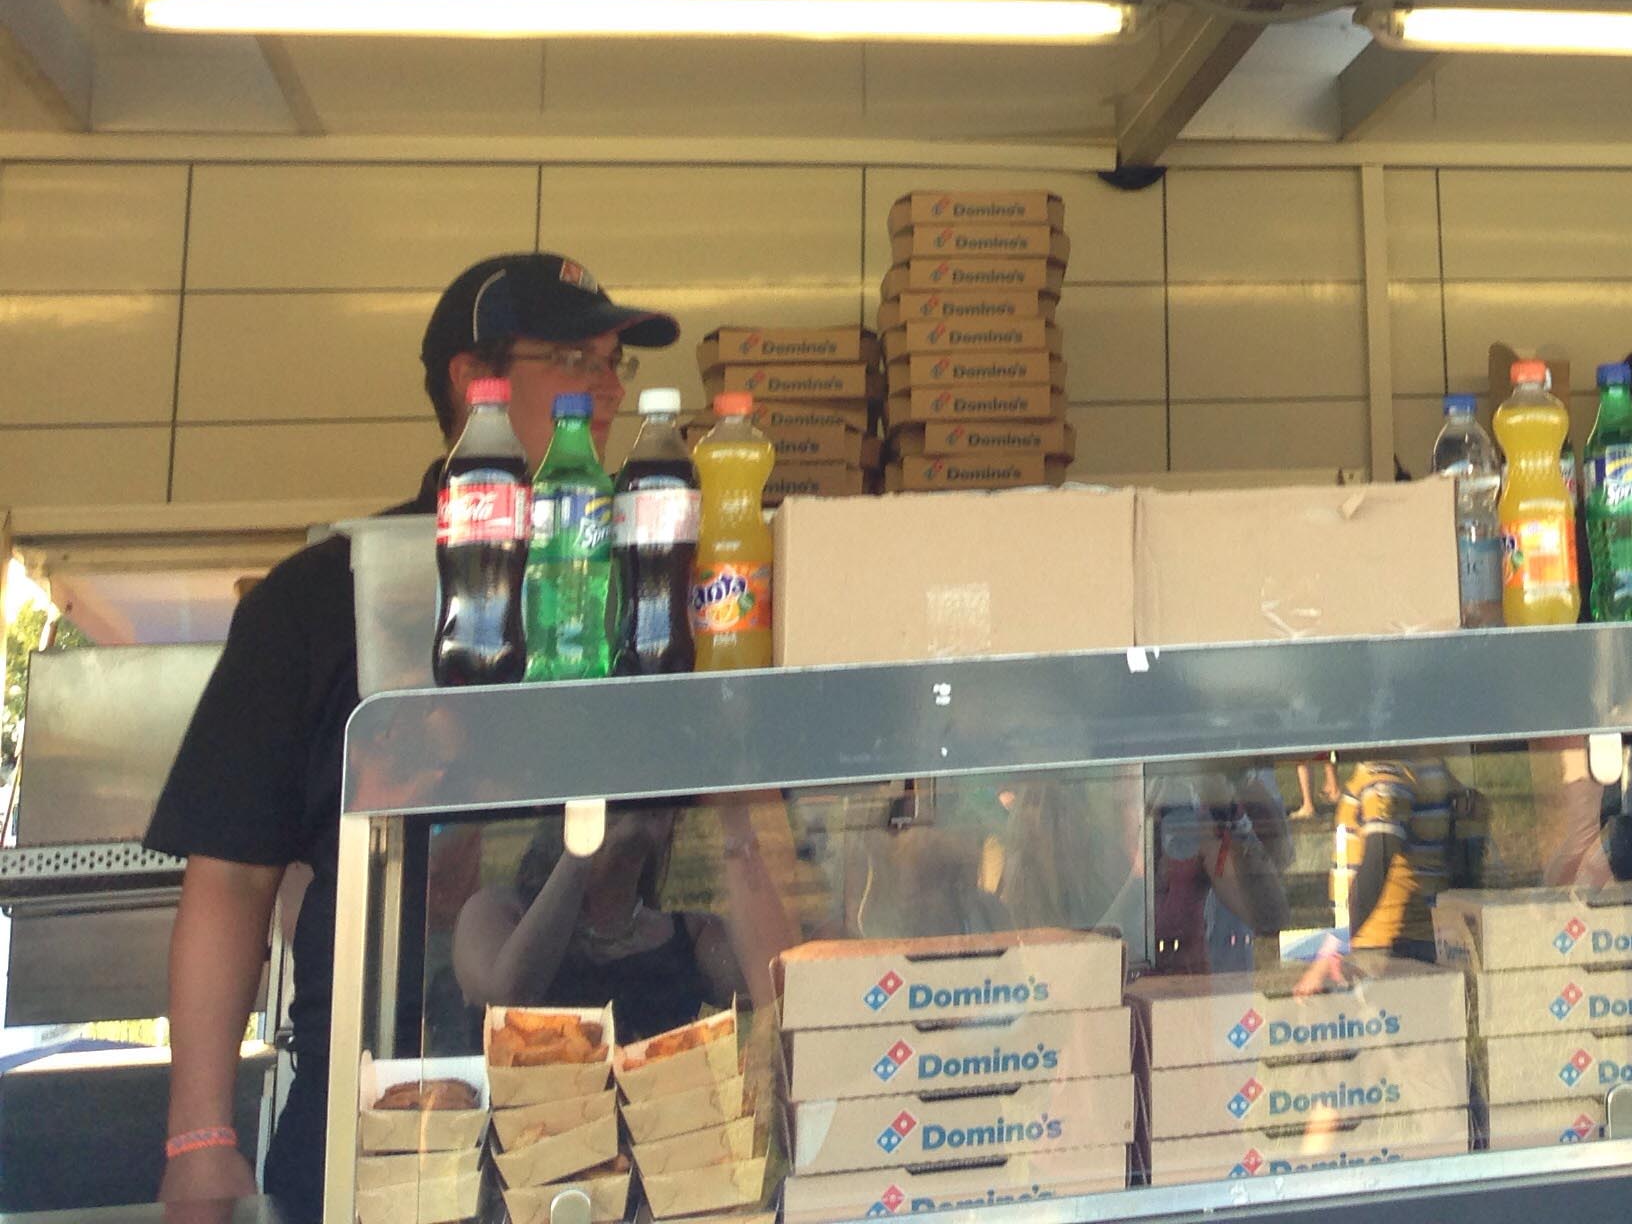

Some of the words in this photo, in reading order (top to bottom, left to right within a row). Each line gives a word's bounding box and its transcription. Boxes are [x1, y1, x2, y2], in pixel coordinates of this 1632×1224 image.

[908, 976, 1049, 1010] Domino's
[1268, 1009, 1401, 1046] Domino's
[917, 1043, 1058, 1080] Domino's
[1268, 1077, 1401, 1115] Domino's
[921, 1112, 1062, 1150] Domino's
